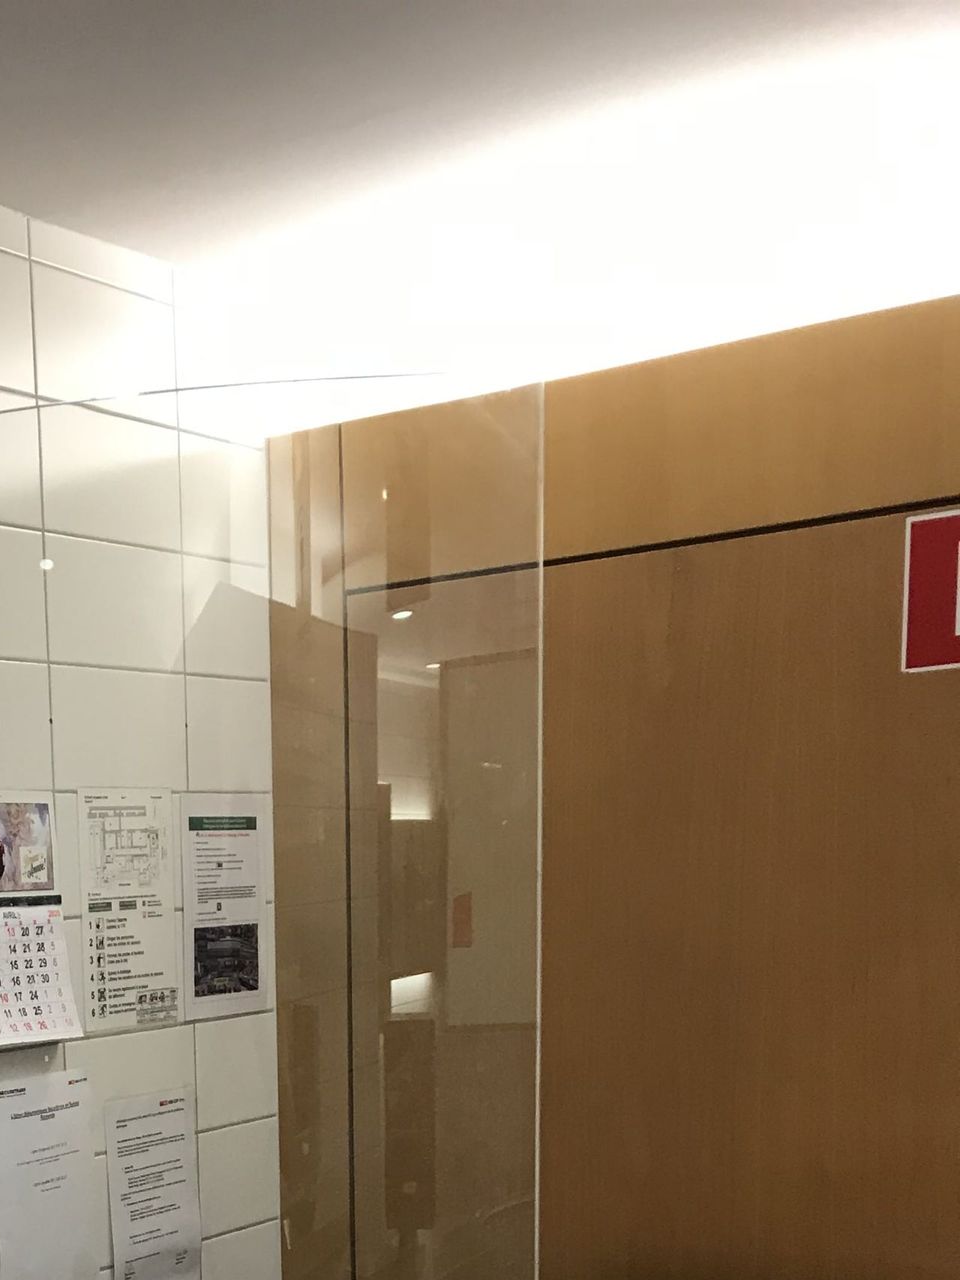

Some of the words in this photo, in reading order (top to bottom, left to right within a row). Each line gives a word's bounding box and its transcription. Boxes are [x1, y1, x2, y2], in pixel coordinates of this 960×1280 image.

[7, 928, 16, 938] 13
[21, 926, 30, 937] 20
[36, 926, 44, 936] 27
[9, 945, 17, 955] 14
[23, 943, 31, 954] 21
[37, 942, 45, 953] 28
[10, 961, 18, 971] 15
[24, 959, 34, 970] 22
[39, 958, 47, 968] 29
[11, 976, 21, 986] 16
[41, 974, 49, 983] 30
[0, 993, 9, 1004] 10
[14, 991, 23, 1002] 17
[29, 990, 39, 1001] 24
[4, 1009, 13, 1019] 11
[18, 1008, 28, 1017] 18
[33, 1006, 43, 1016] 25
[10, 1024, 19, 1033] 12
